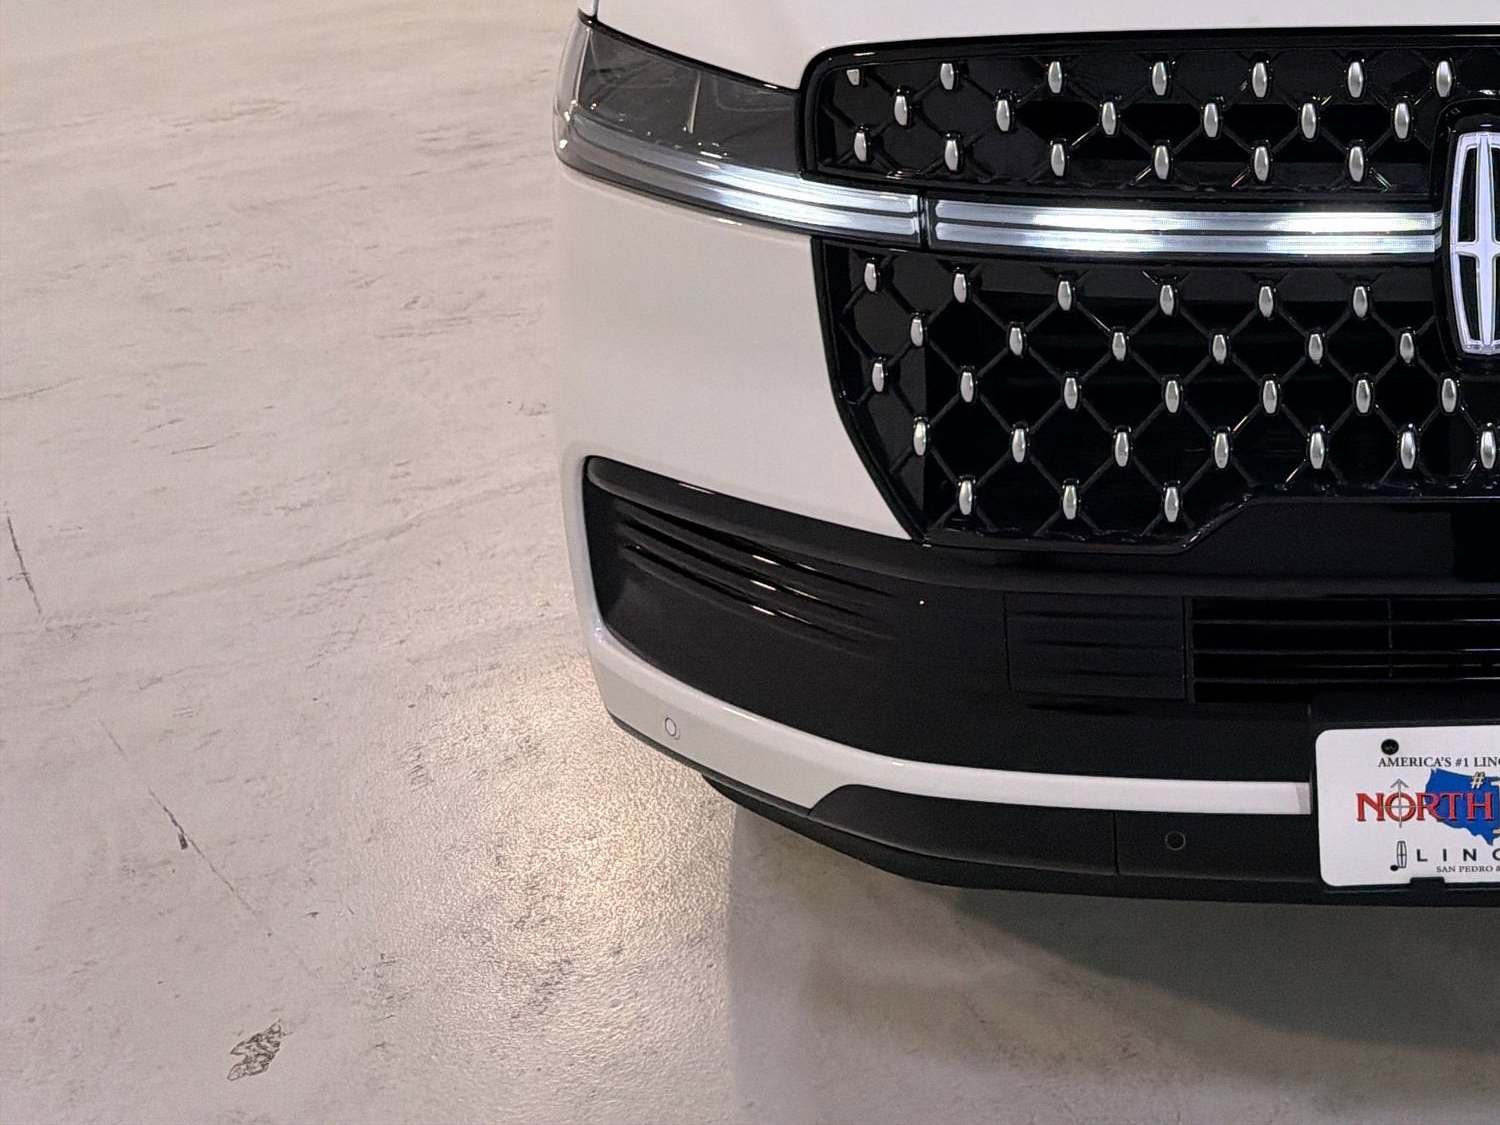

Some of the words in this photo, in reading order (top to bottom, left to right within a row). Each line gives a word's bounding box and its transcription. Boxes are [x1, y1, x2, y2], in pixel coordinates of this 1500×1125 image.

[1378, 756, 1452, 768] AMERICA'S
[1455, 756, 1469, 767] #1
[1356, 790, 1494, 822] NORTH
[1436, 865, 1456, 873] SAN
[1459, 864, 1494, 873] PEDRO
